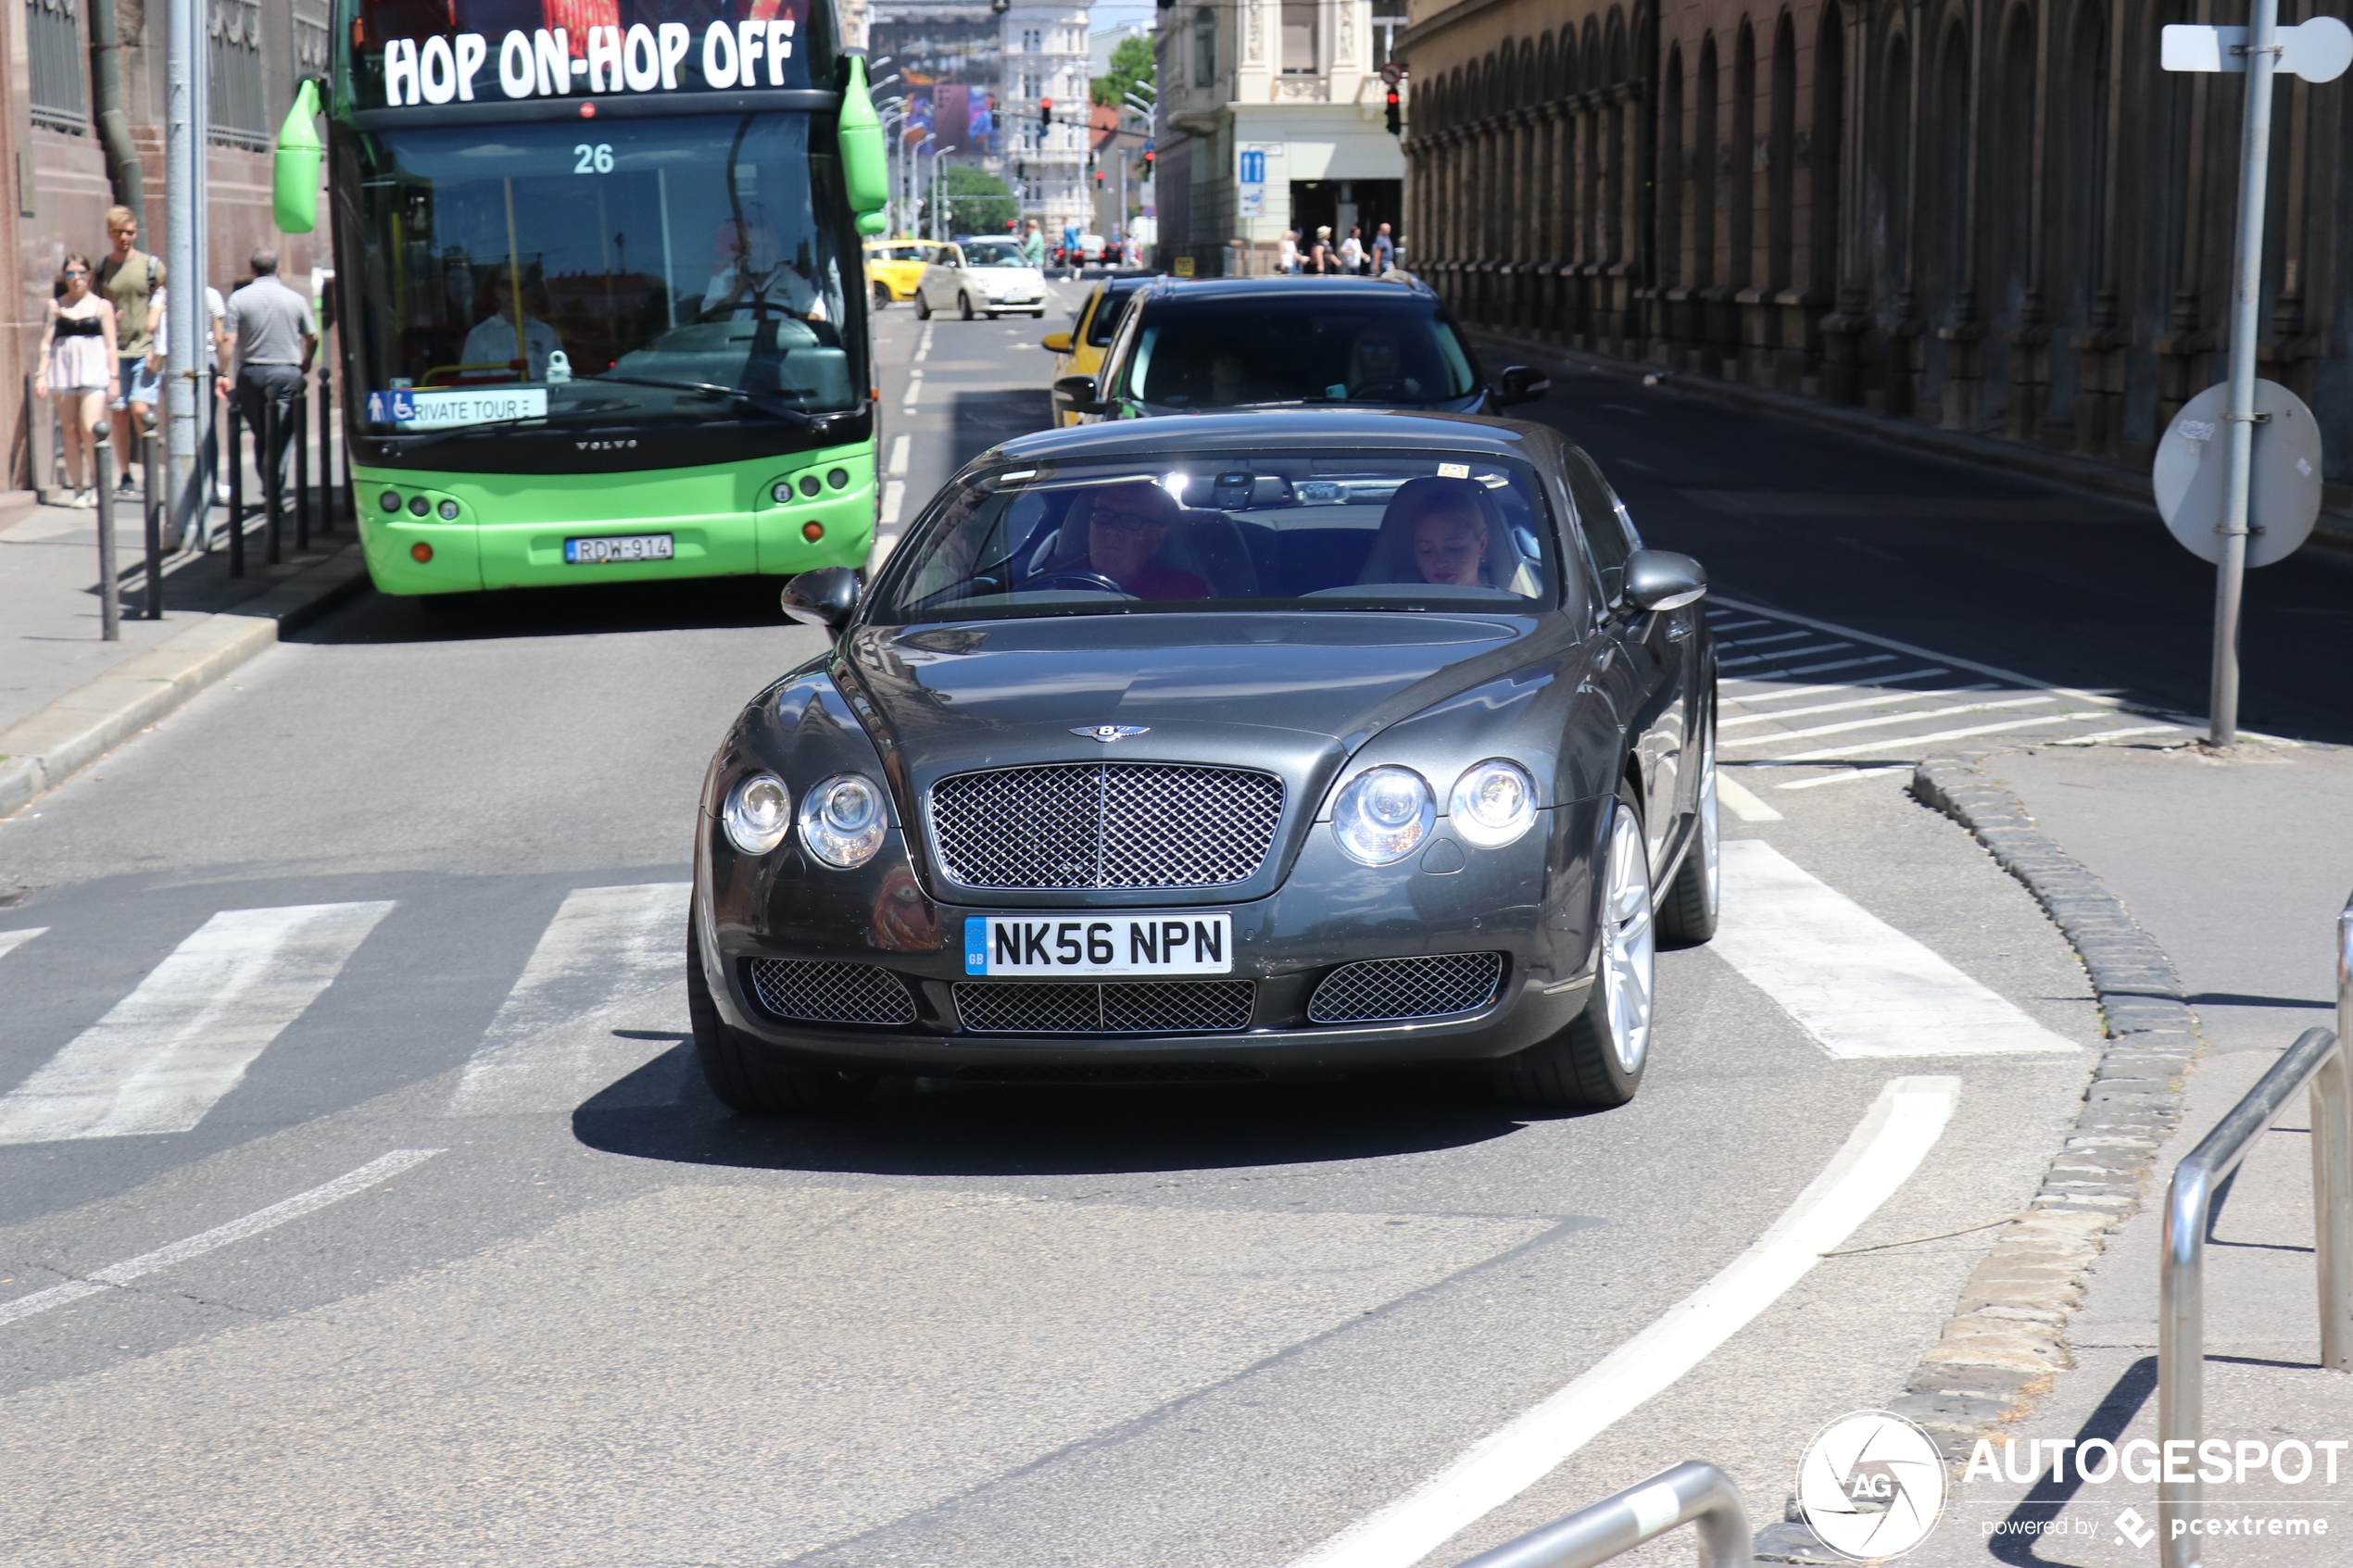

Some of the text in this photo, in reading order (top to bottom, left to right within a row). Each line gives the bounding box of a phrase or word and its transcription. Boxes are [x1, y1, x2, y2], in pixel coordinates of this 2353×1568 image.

[384, 19, 796, 107] HOP ON-HOP OFF
[573, 143, 615, 174] 26
[414, 401, 468, 420] RIVATE
[473, 399, 517, 419] TOUR
[575, 439, 638, 451] VOLVO
[580, 537, 668, 559] RDW-914
[995, 921, 1222, 965] NK56 NPN
[968, 953, 984, 965] GB
